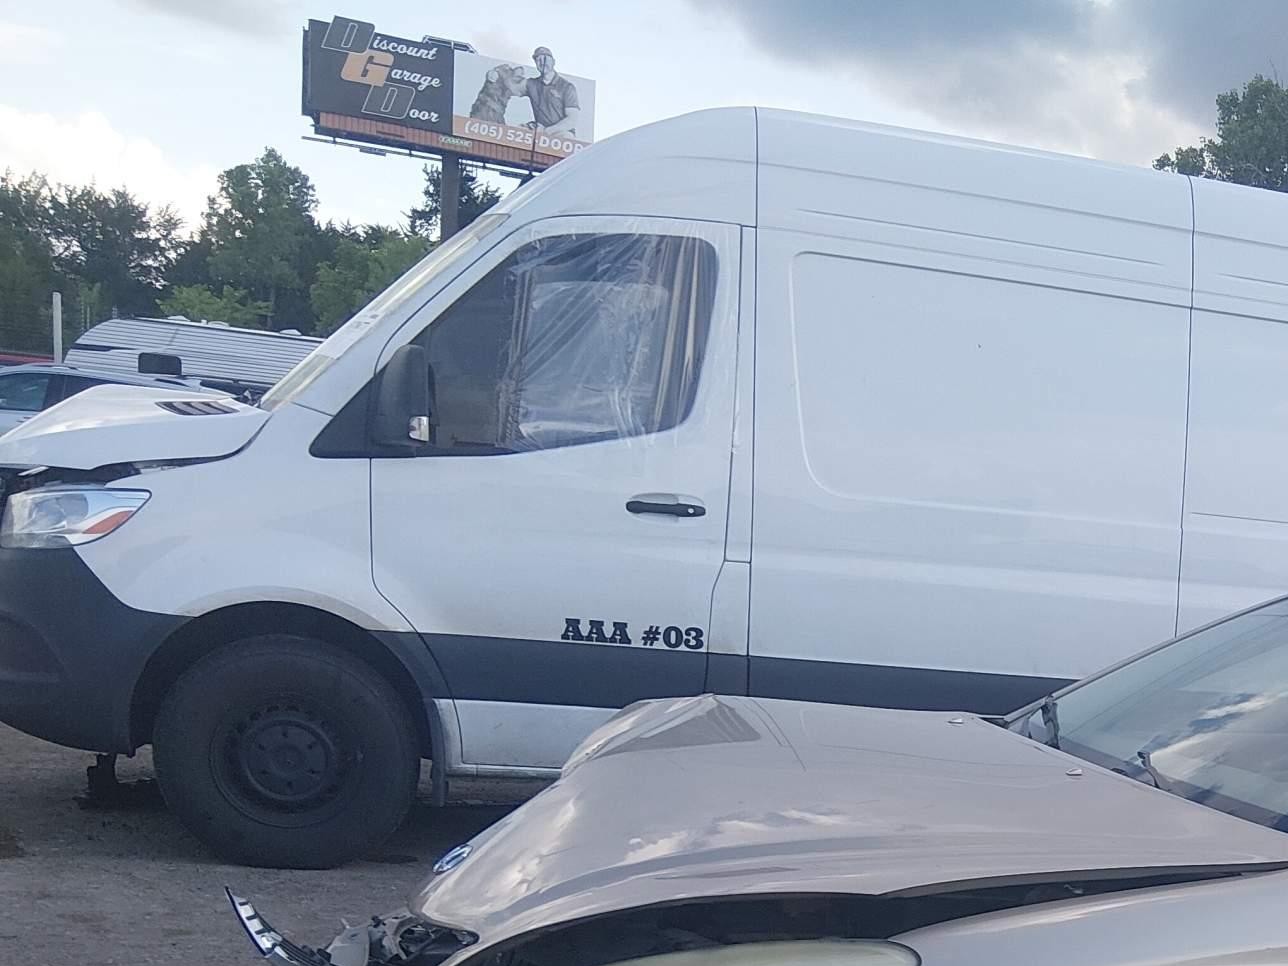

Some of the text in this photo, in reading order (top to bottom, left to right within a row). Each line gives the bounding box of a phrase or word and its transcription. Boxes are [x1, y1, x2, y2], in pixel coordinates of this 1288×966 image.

[321, 15, 437, 60] Discount
[340, 49, 442, 90] Garage
[361, 82, 440, 123] Door
[464, 120, 503, 140] (405)
[561, 618, 704, 650] AAA #03
